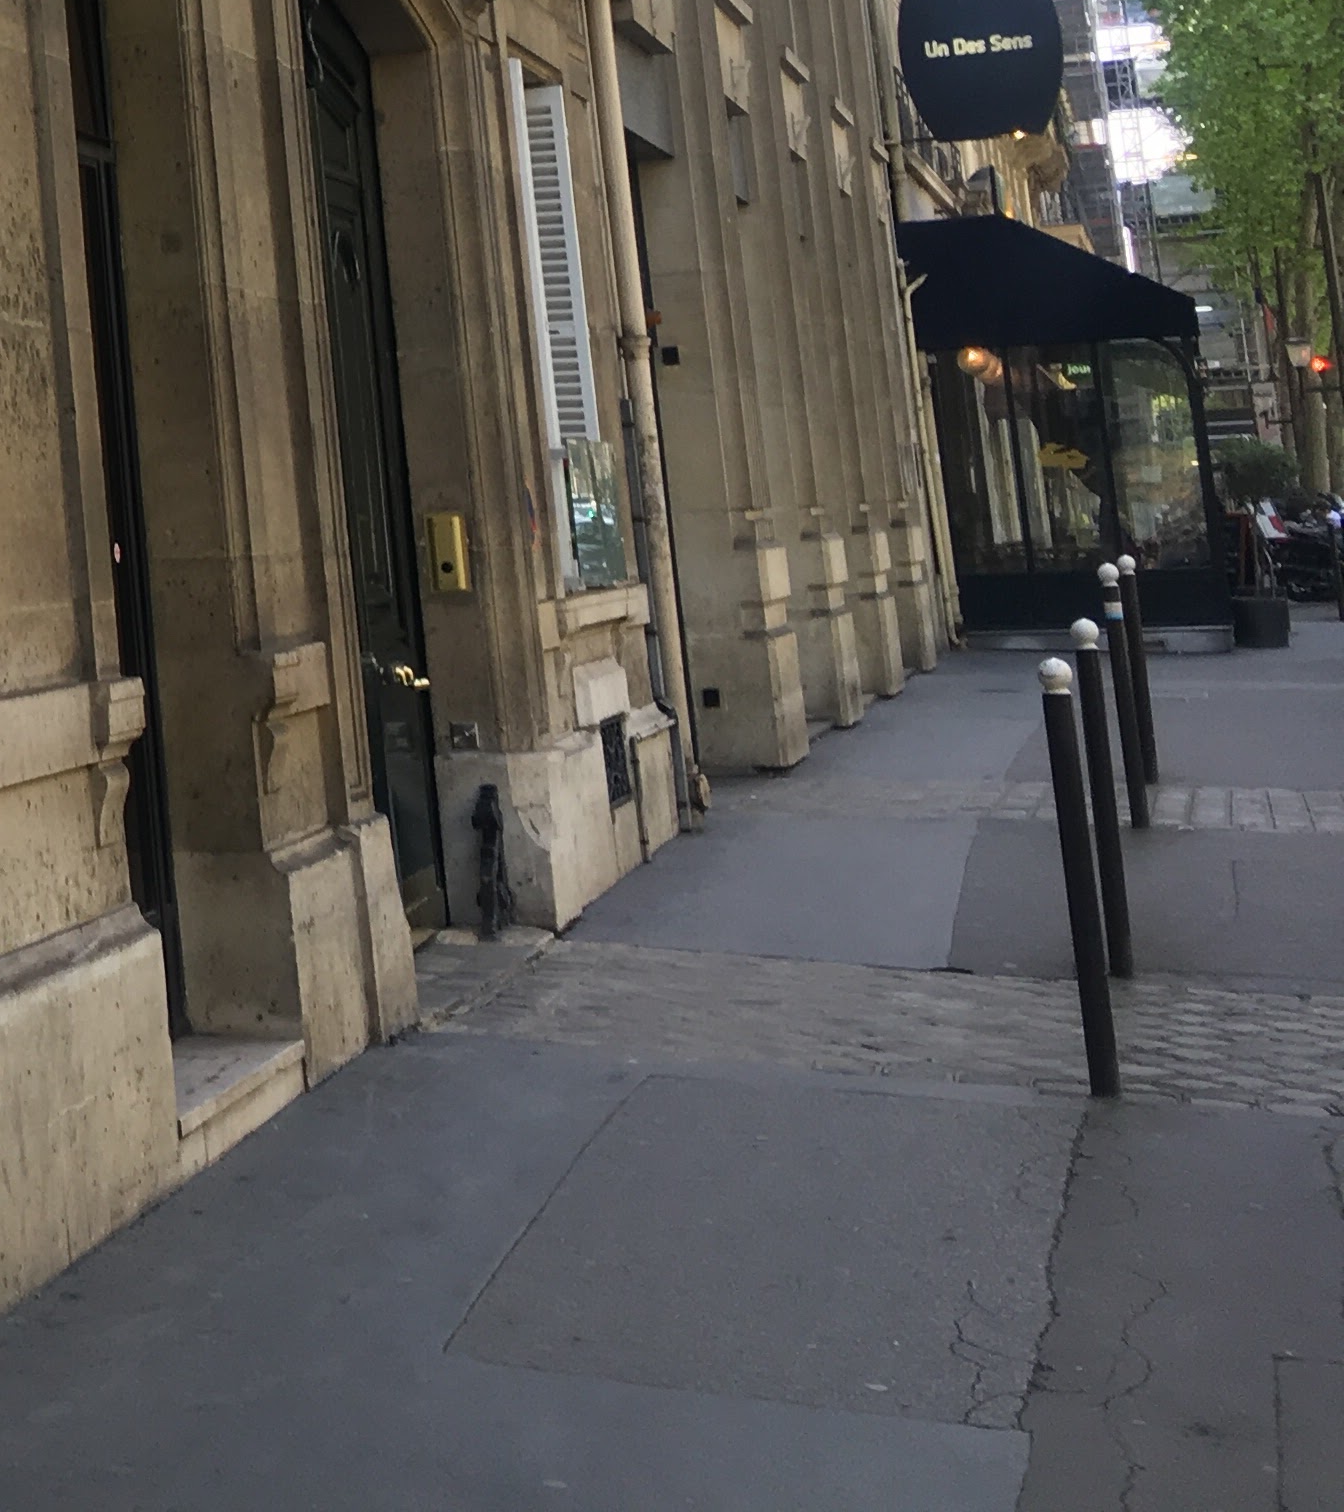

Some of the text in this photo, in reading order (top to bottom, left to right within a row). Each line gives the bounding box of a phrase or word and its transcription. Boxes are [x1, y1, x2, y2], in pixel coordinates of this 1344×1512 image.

[924, 34, 1033, 59] Un Des Sens
